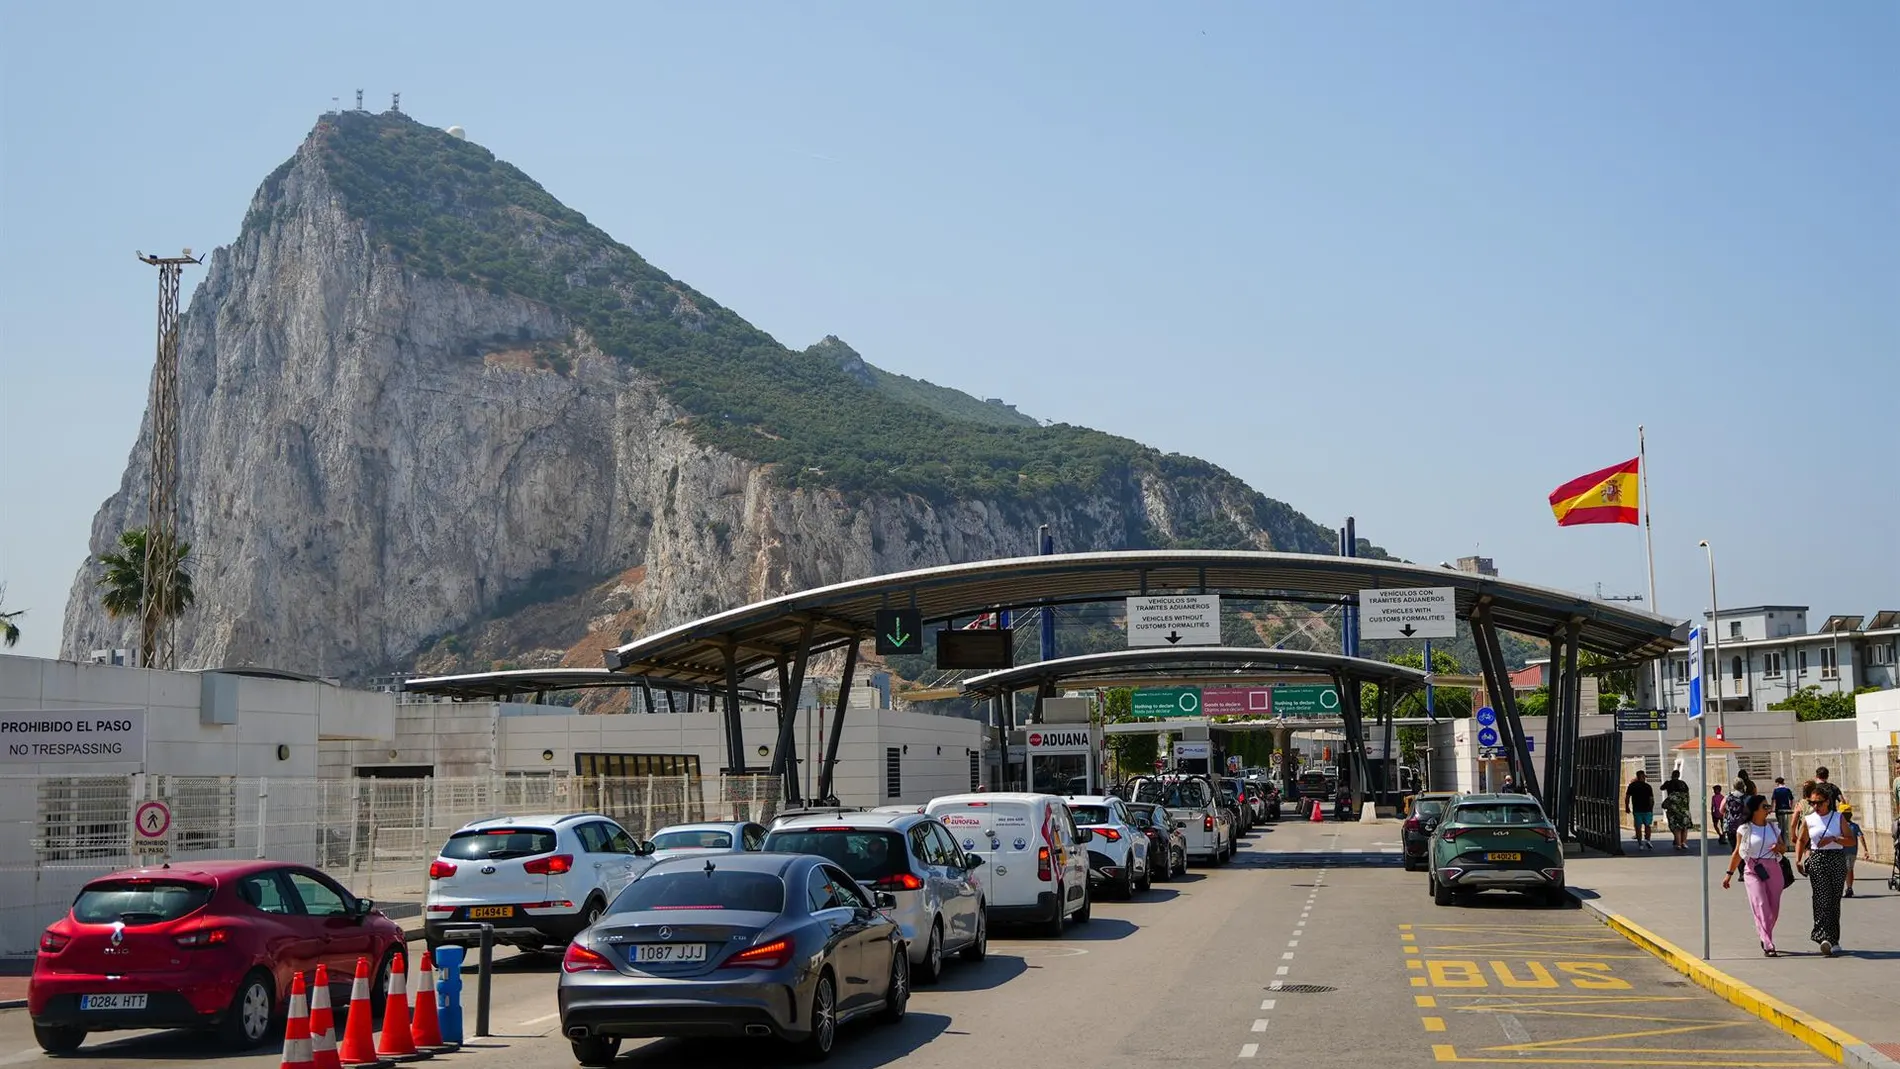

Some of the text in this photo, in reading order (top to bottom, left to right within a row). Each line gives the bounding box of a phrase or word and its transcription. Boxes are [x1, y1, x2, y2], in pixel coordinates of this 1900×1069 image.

[1, 720, 132, 733] PROHIBIDO EL PASO
[1042, 733, 1089, 746] ADUANA
[9, 743, 122, 756] NO TRESPASSING
[640, 946, 702, 960] 1087 JJJ
[1425, 960, 1633, 989] BUS
[90, 995, 145, 1007] 0284 HTT
